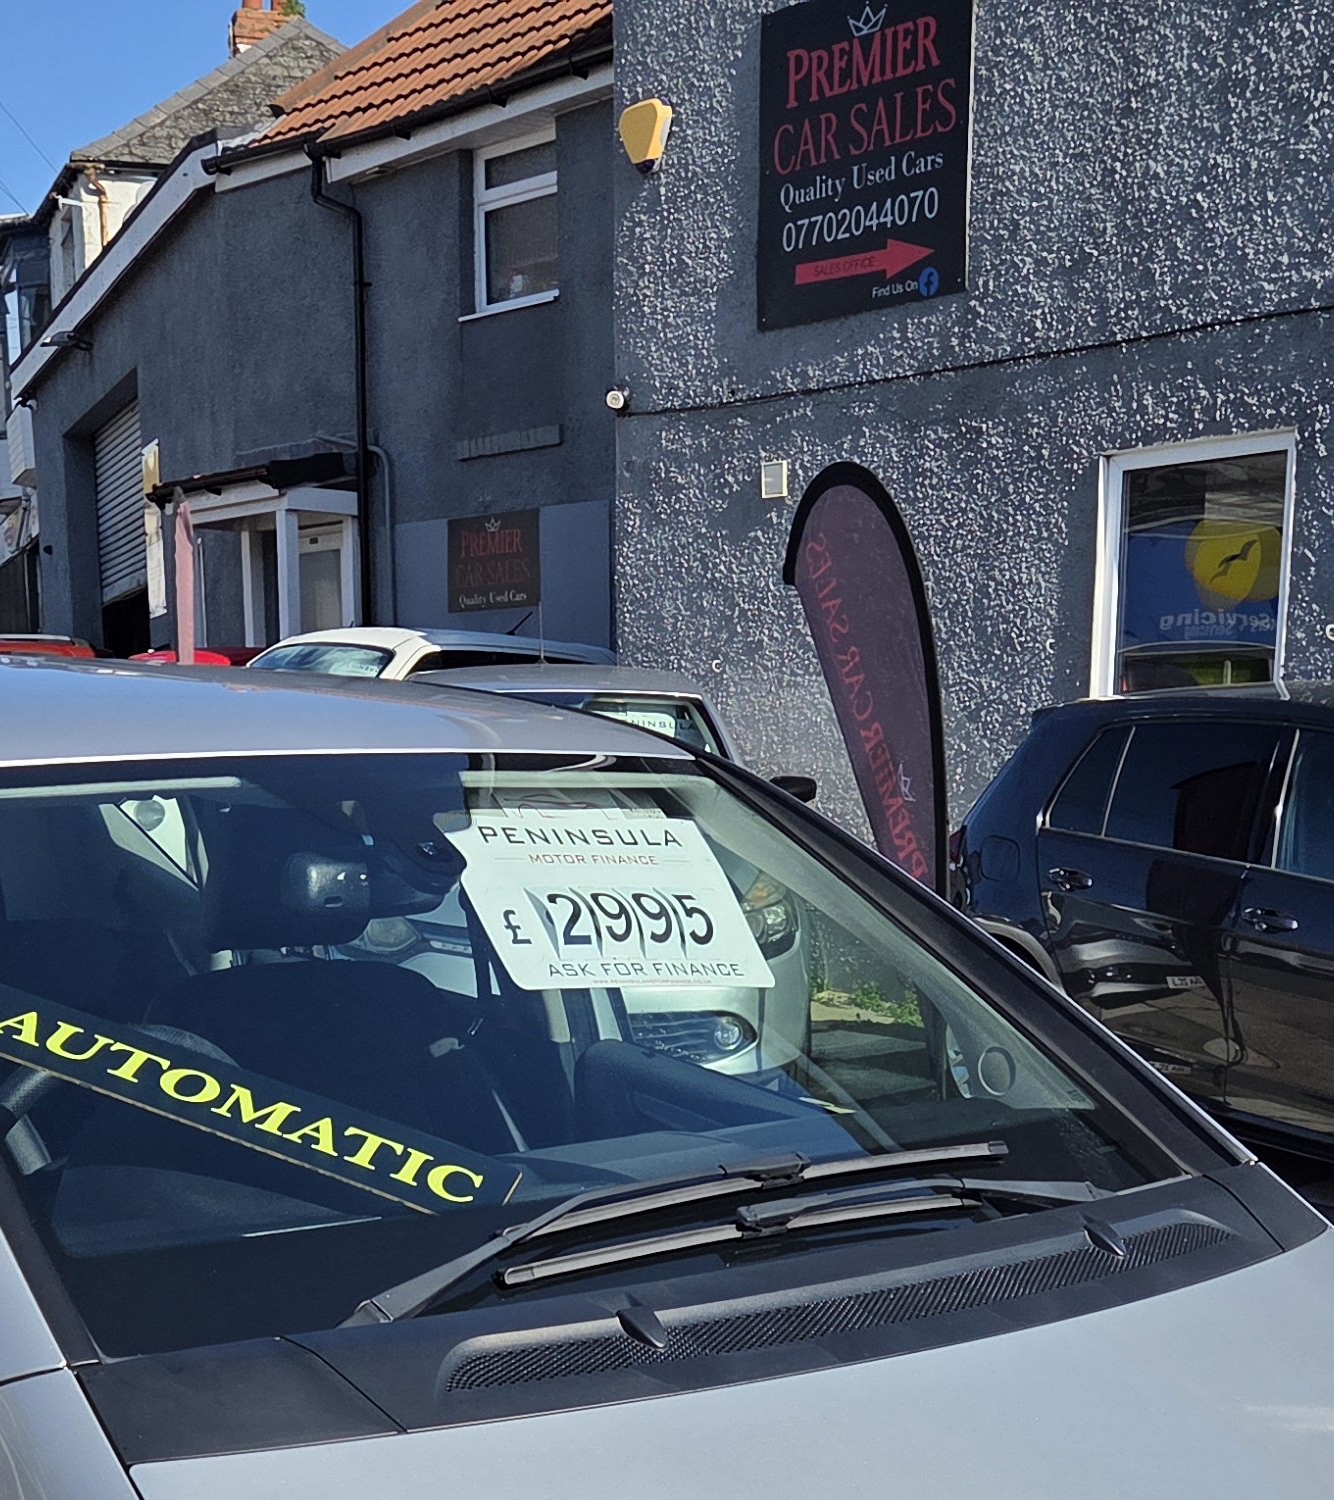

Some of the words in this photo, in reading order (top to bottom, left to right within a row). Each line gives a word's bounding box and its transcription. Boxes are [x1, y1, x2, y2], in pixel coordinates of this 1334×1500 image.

[786, 15, 941, 109] PREMIER
[774, 114, 843, 176] CAR
[849, 77, 957, 156] SALES
[779, 173, 846, 213] Quality
[851, 156, 896, 190] Used
[901, 149, 944, 180] Cars
[781, 186, 939, 253] 07702044070
[813, 263, 841, 277] SALES
[842, 256, 875, 271] OFFICE
[872, 284, 890, 299] Find
[892, 283, 904, 295] Us
[905, 280, 919, 292] On
[460, 528, 524, 558] PREMIER
[456, 561, 486, 588] CAR
[487, 557, 531, 585] SALES
[459, 594, 486, 609] Quality
[489, 591, 508, 603] Used
[509, 590, 527, 601] Cars
[477, 826, 683, 848] PENINSULA
[528, 853, 589, 865] MOTOR
[593, 854, 660, 866] FINANCE
[504, 909, 532, 945] £
[548, 892, 714, 947] 2995
[549, 962, 596, 978] ASK
[600, 962, 648, 977] FOR
[651, 962, 745, 977] FINANCE
